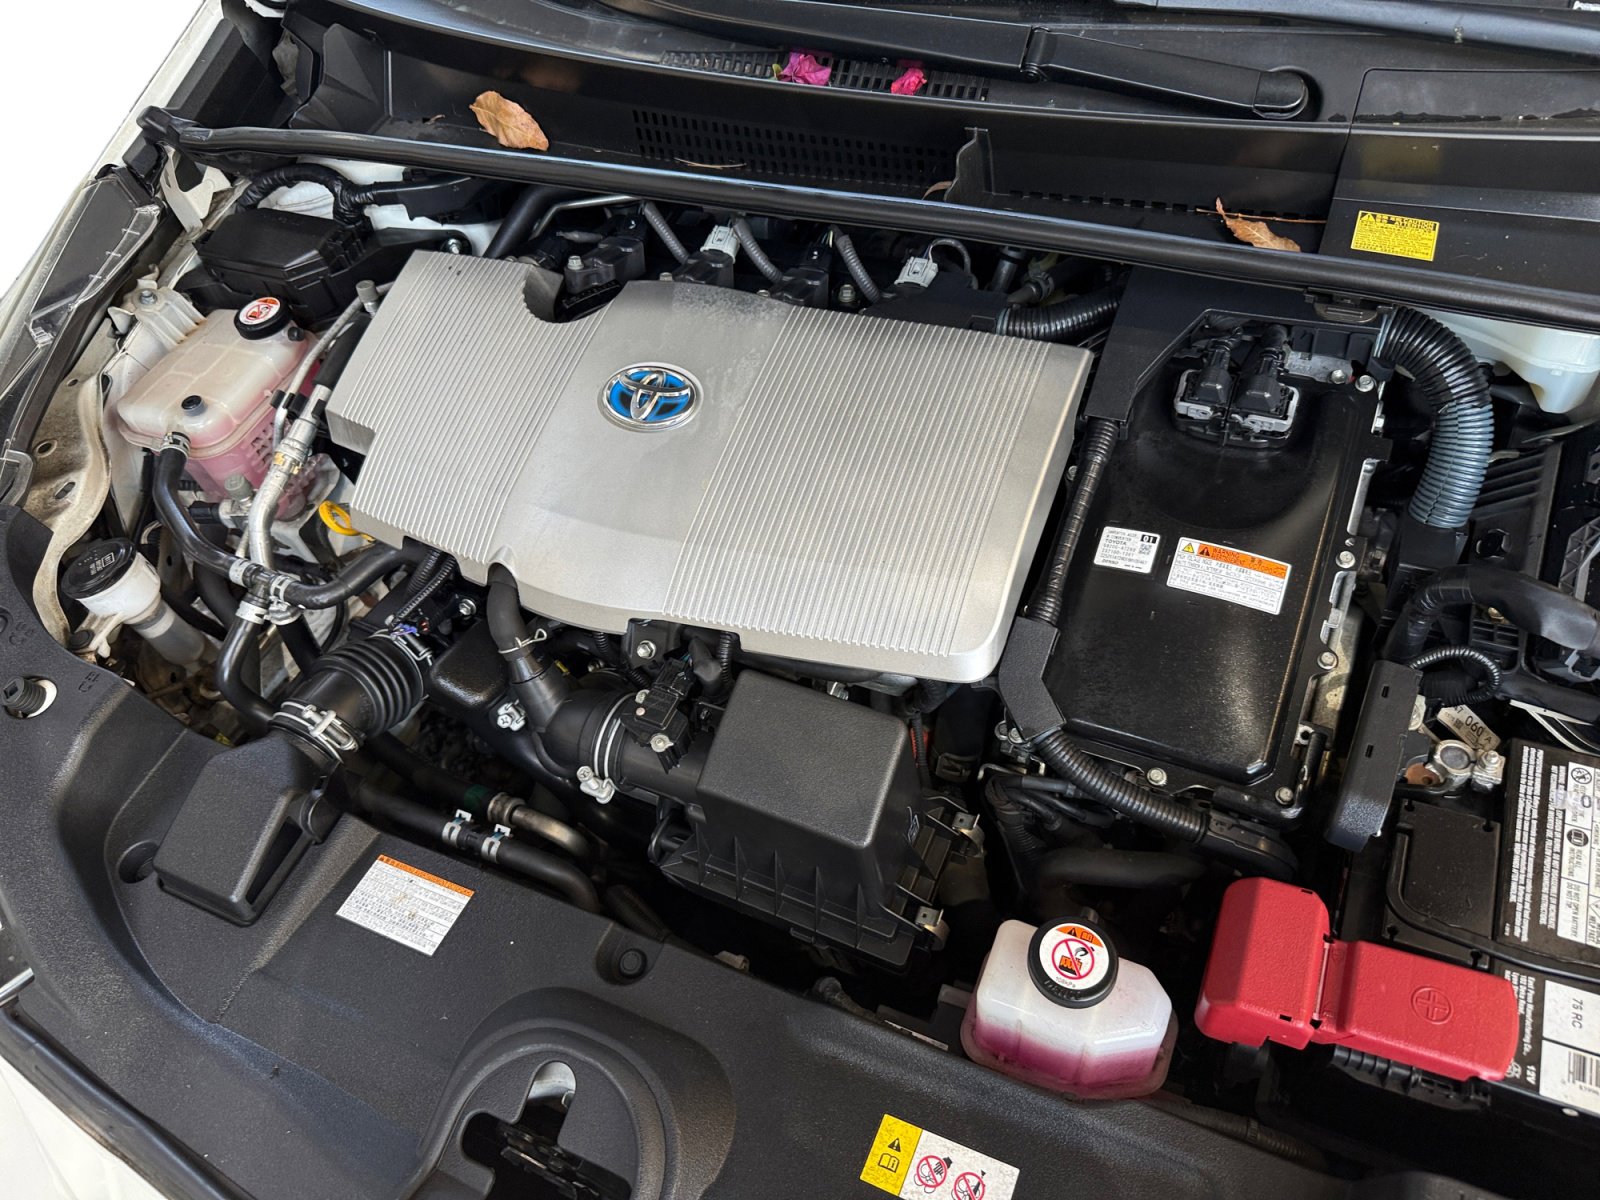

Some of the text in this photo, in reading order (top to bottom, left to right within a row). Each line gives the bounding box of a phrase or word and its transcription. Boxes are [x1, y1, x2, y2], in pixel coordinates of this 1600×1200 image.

[1105, 538, 1127, 546] TOYOTA
[1143, 536, 1154, 544] 01
[1465, 715, 1484, 736] 060
[1484, 736, 1492, 744] A
[1527, 975, 1535, 989] East
[1526, 988, 1534, 1003] Penn
[1523, 1002, 1534, 1043] Manufacturing
[1571, 1011, 1583, 1029] RC
[1525, 1064, 1536, 1085] 12V
